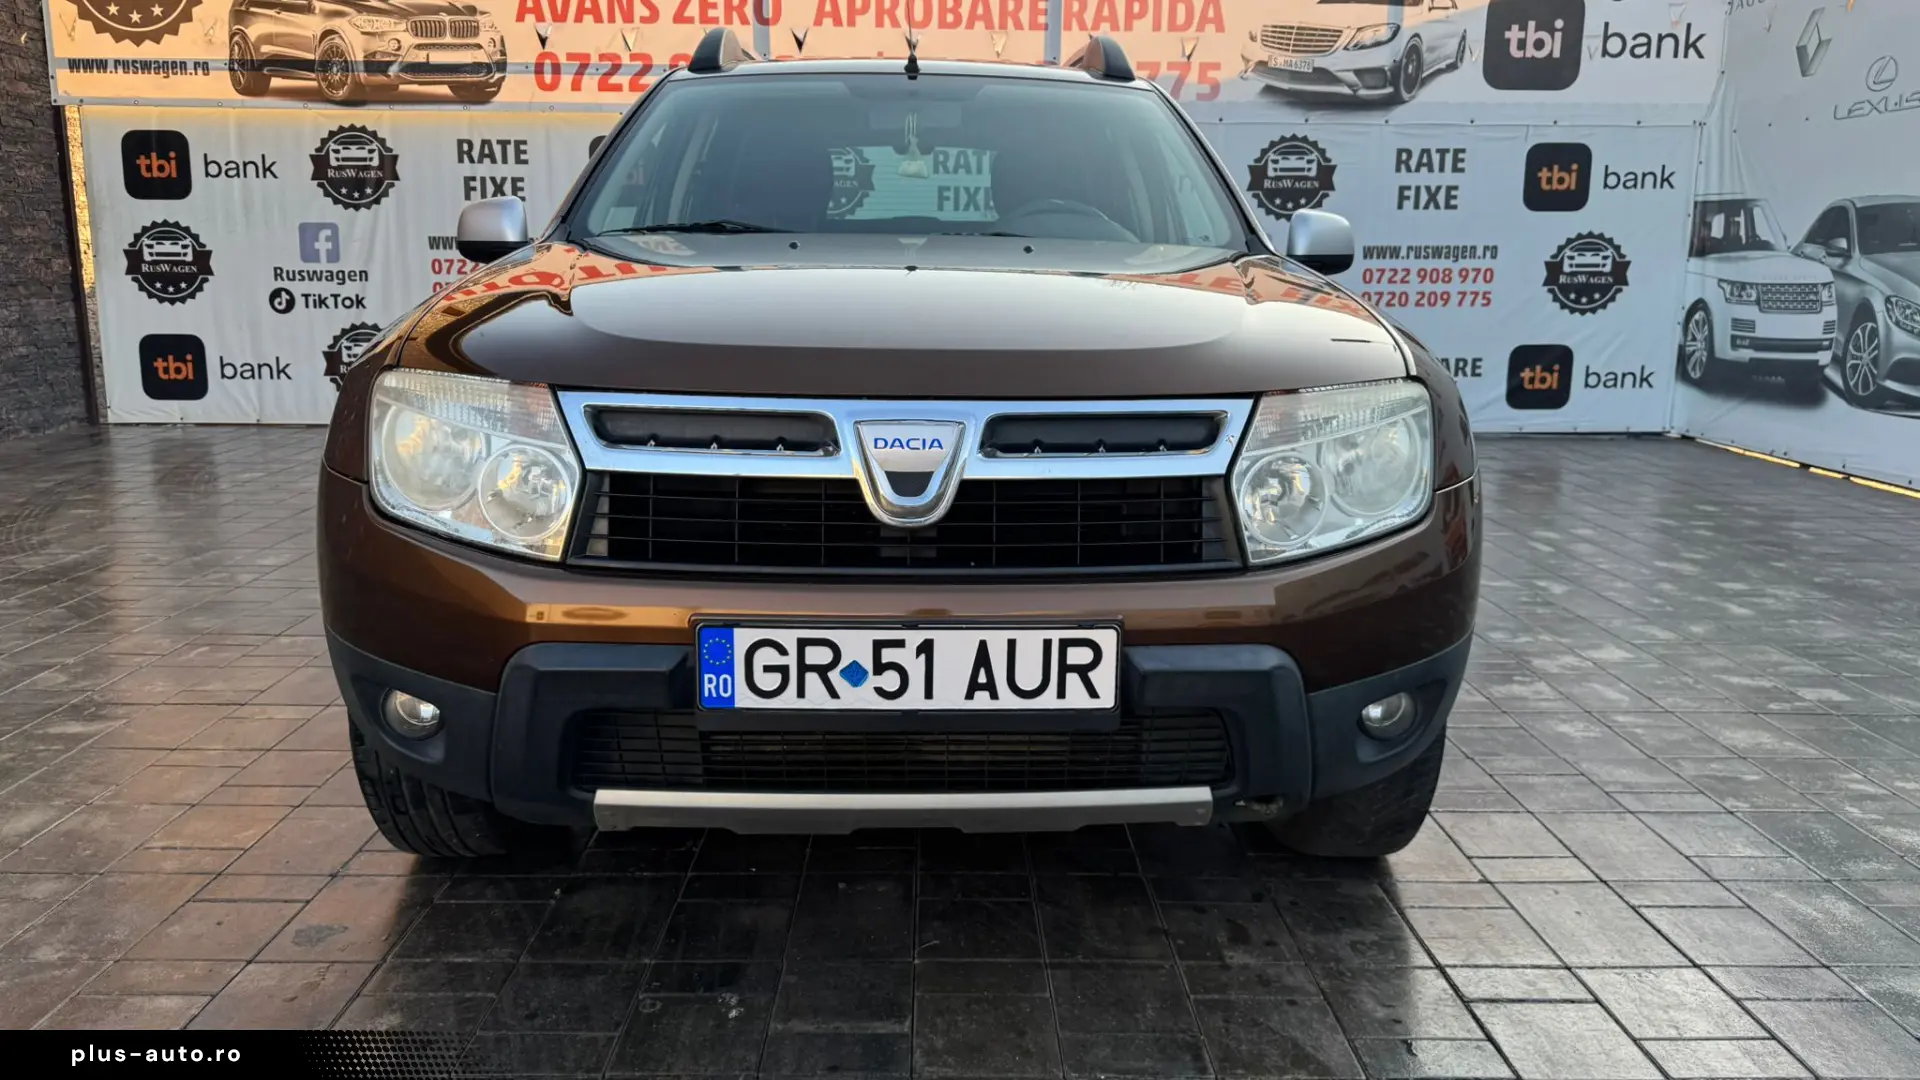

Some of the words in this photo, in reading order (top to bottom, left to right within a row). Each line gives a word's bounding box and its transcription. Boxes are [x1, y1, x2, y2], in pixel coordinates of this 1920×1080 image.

[515, 0, 660, 24] AVANS
[672, 0, 782, 26] ZERO
[813, 0, 1048, 31] APROBARE
[1063, 0, 1225, 33] RAPIDA
[1505, 19, 1564, 59] tbi
[1601, 21, 1706, 60] bank
[68, 58, 210, 78] www.ruswagen.ro
[534, 52, 654, 93] 0722
[456, 138, 529, 165] RATE
[1395, 148, 1467, 173] RATE
[136, 151, 178, 178] tbi
[204, 153, 279, 179] bank
[1537, 163, 1578, 190] tbi
[1602, 164, 1676, 190] bank
[463, 175, 526, 202] FIXE
[1396, 185, 1460, 210] FIXE
[1362, 244, 1499, 262] www.ruswagen.ro
[273, 266, 369, 285] Ruswagen
[1362, 268, 1411, 284] 0722
[1416, 267, 1454, 284] 908
[1458, 267, 1495, 284] 970
[301, 293, 368, 309] TikTok
[1361, 291, 1410, 308] 0720
[1414, 291, 1451, 308] 209
[1457, 291, 1493, 308] 775
[153, 353, 195, 380] tbi
[219, 356, 293, 380] bank
[1519, 363, 1560, 390] tbi
[1584, 364, 1655, 389] bank
[873, 437, 944, 451] DACIA
[744, 637, 842, 700] GR
[872, 638, 935, 700] 51
[964, 638, 1103, 700] AUR
[704, 673, 733, 698] RO
